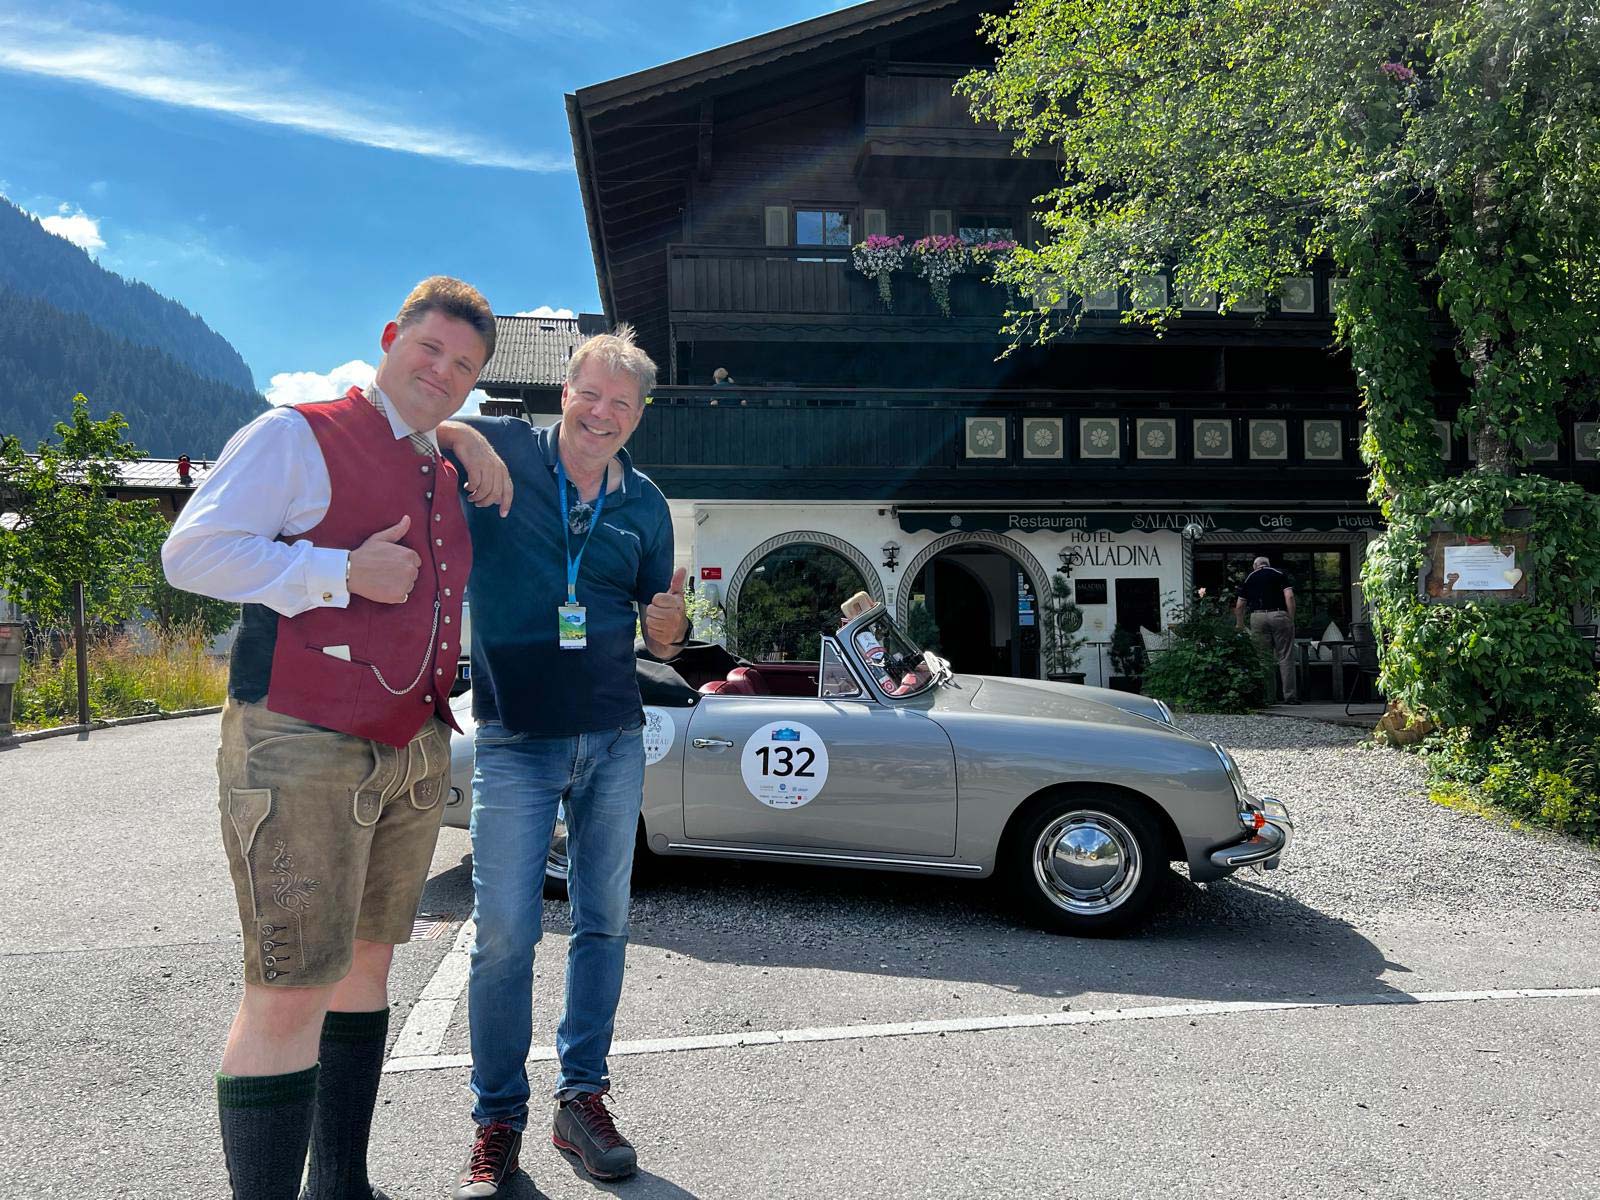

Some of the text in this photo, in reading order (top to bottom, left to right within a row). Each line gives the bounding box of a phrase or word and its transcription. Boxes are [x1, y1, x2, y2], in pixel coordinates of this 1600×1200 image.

[1008, 513, 1374, 529] Restaurant SALADINA Cafe Hotel
[1071, 532, 1116, 543] HOTEL
[1072, 545, 1161, 566] SALADINA
[755, 746, 815, 777] 132
